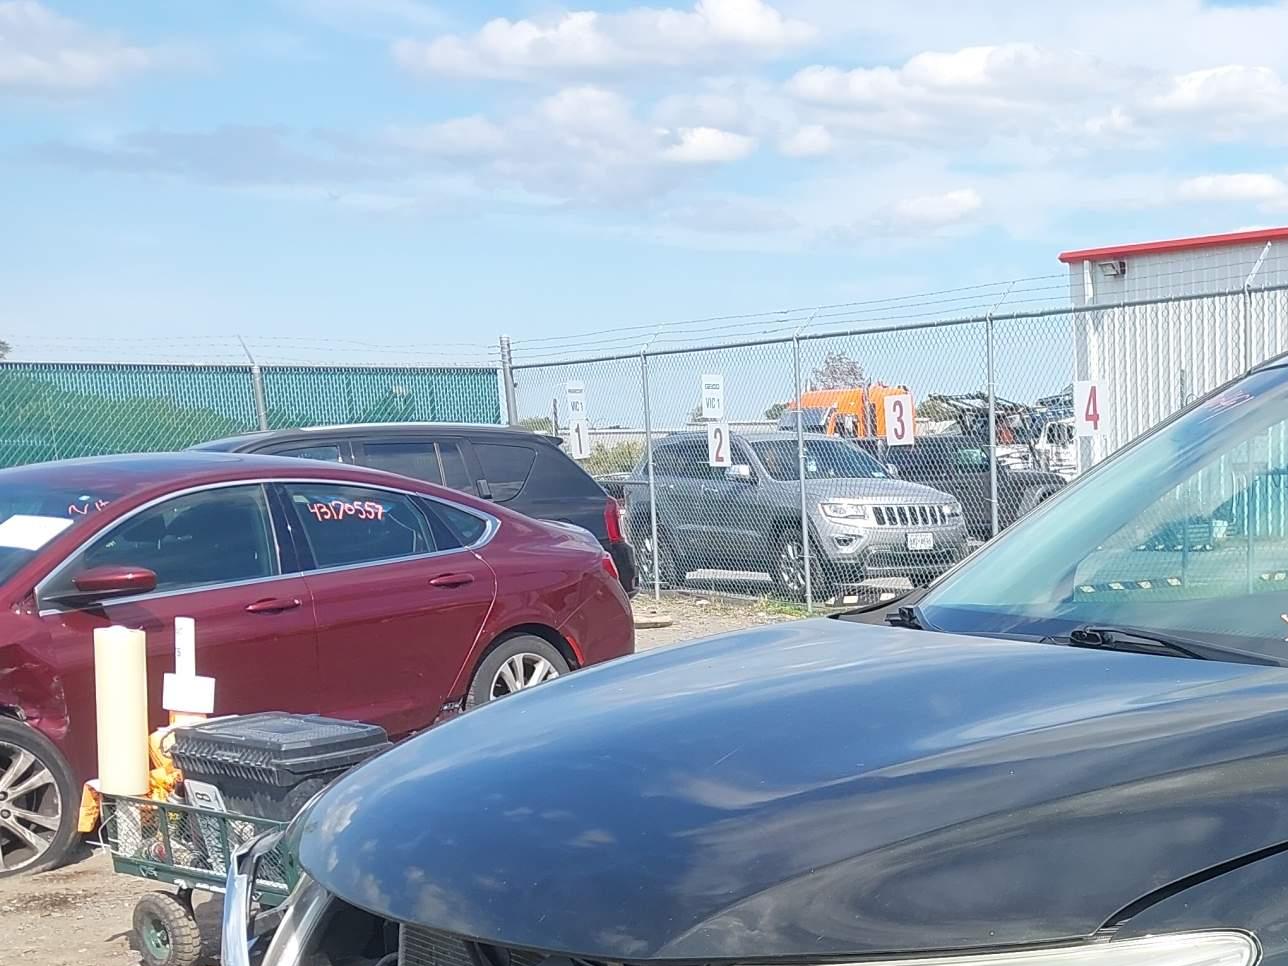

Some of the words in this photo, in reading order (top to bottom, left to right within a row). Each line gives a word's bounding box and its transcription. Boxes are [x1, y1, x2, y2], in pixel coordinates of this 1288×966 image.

[892, 400, 906, 440] 3
[1085, 385, 1100, 430] 4
[575, 423, 583, 454] 1
[713, 427, 725, 462] 2
